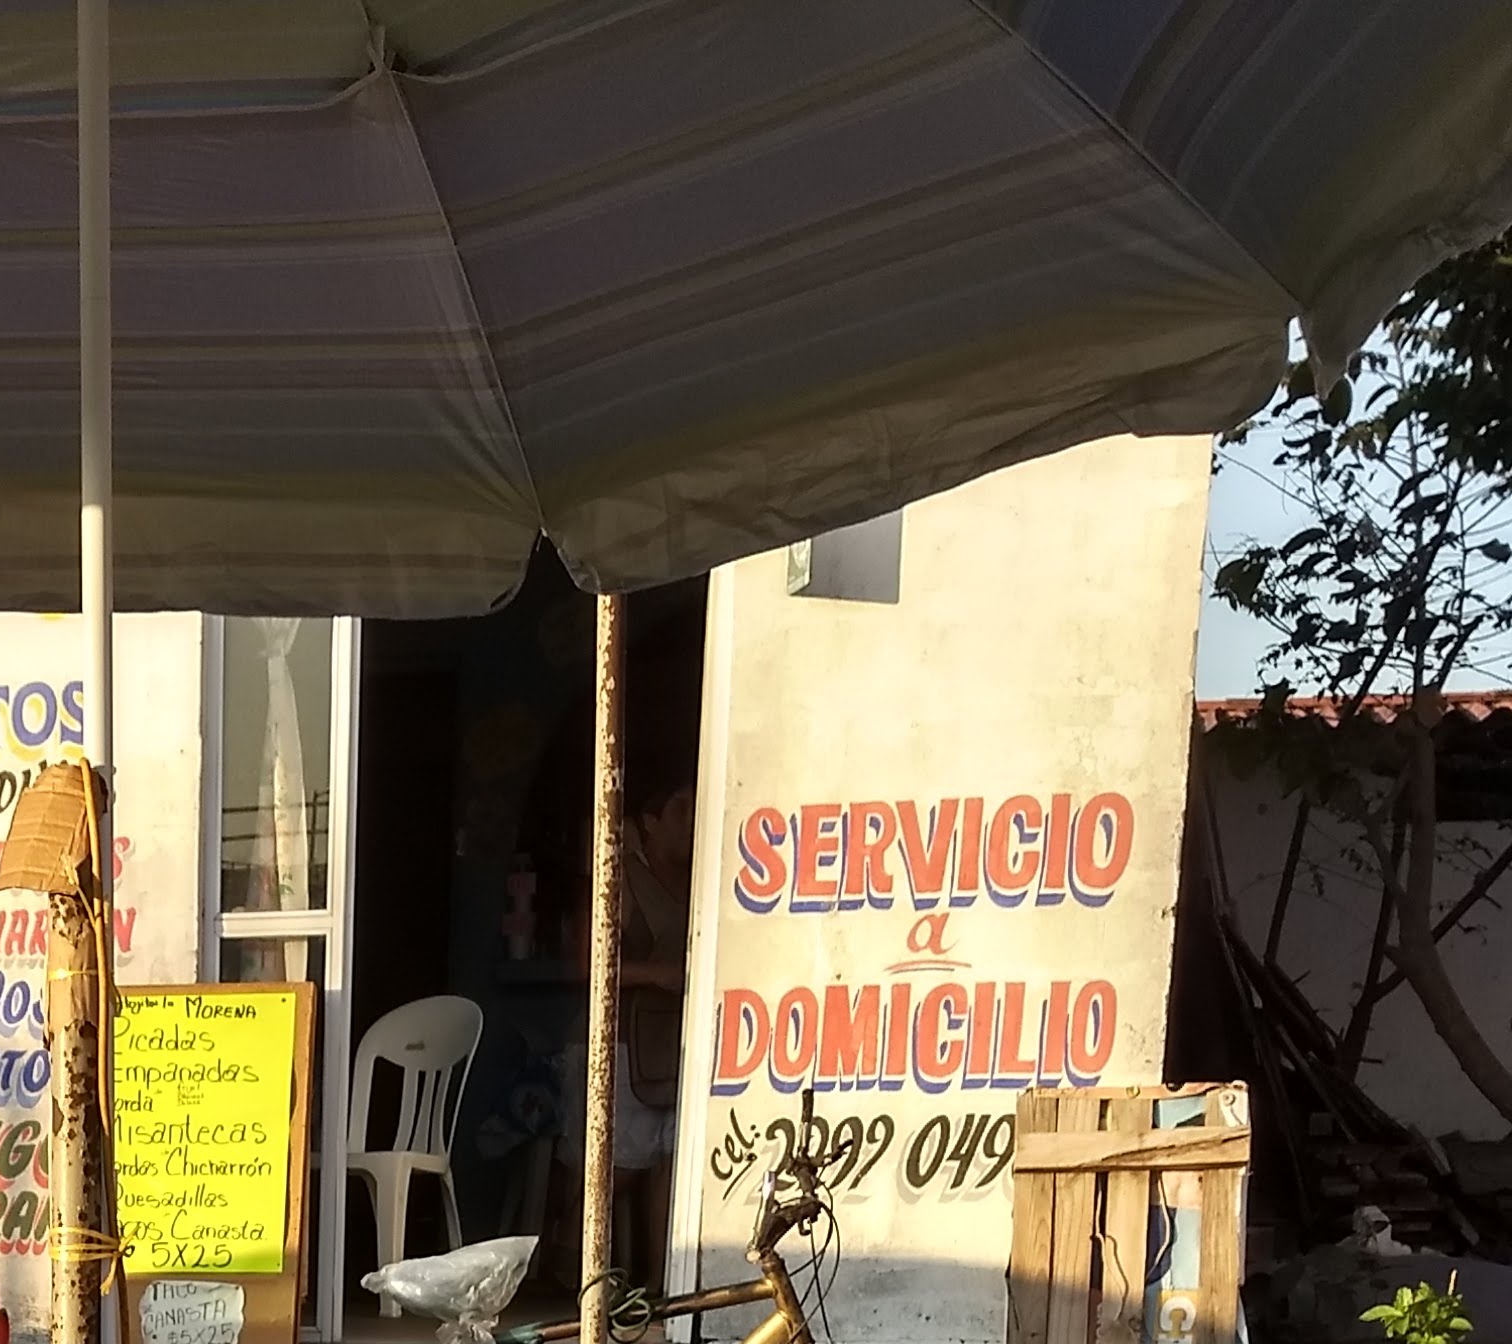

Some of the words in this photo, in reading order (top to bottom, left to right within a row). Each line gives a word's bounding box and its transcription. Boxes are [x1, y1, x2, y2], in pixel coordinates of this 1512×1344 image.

[734, 792, 1135, 914] SERVICIO
[186, 996, 257, 1019] MORENA
[710, 980, 1119, 1097] DOMICILIO
[144, 1298, 227, 1336] CANASTA
